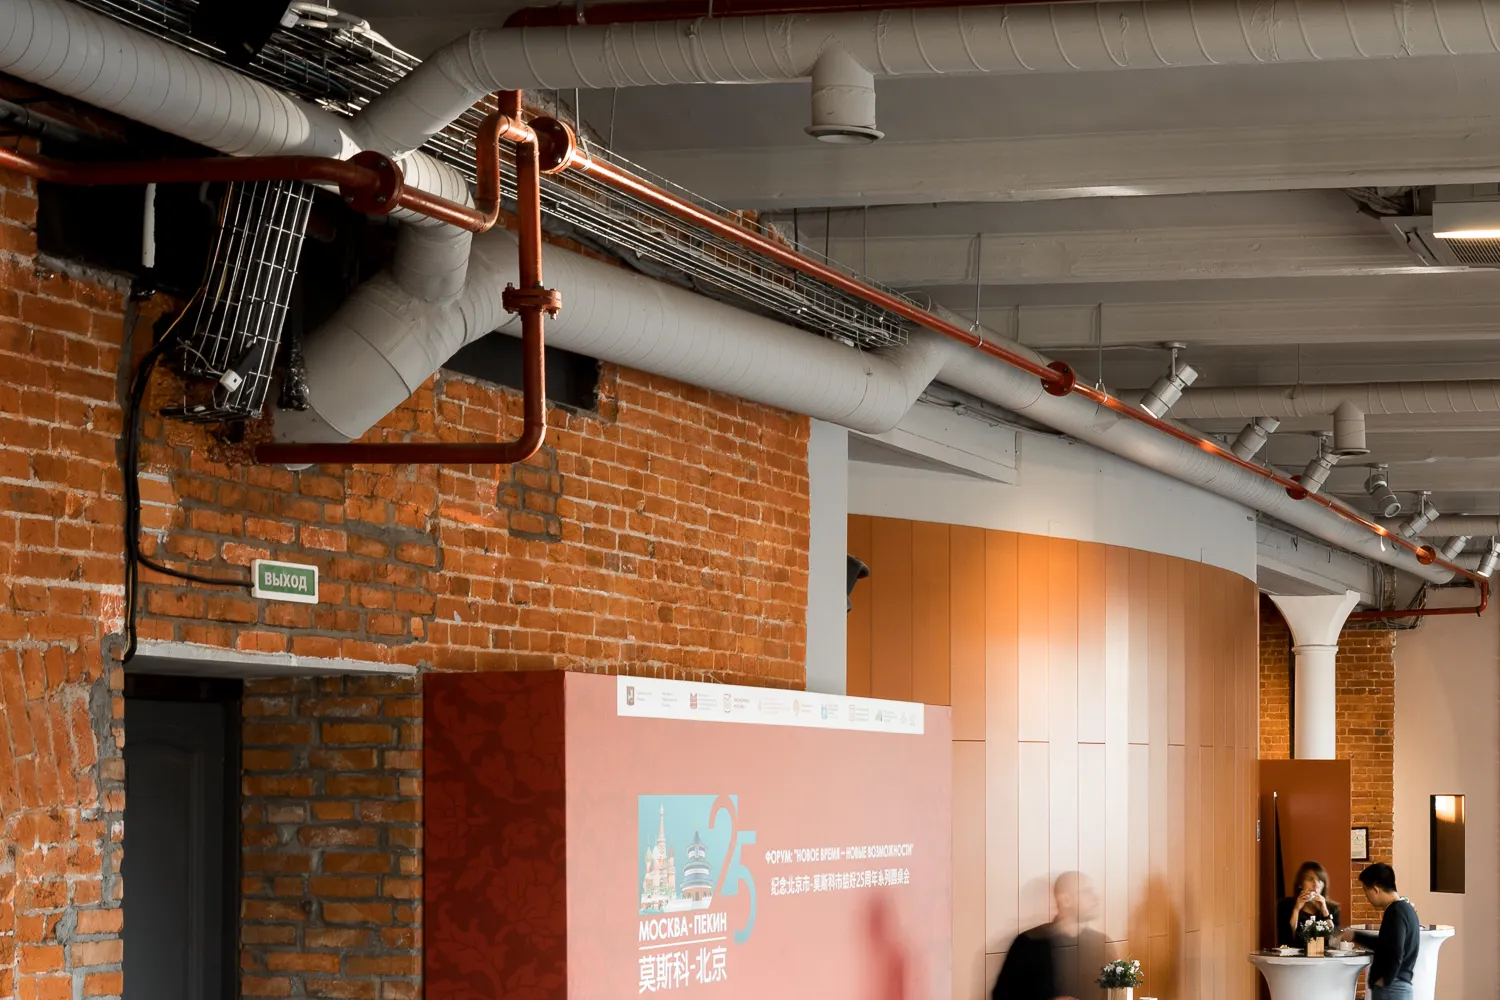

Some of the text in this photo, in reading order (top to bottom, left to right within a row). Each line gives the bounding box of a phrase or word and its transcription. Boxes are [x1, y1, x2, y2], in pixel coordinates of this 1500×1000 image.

[264, 571, 308, 592] ВЫХОД
[765, 849, 793, 865] ФОРУМ:
[845, 845, 867, 860] НОВЫЕ
